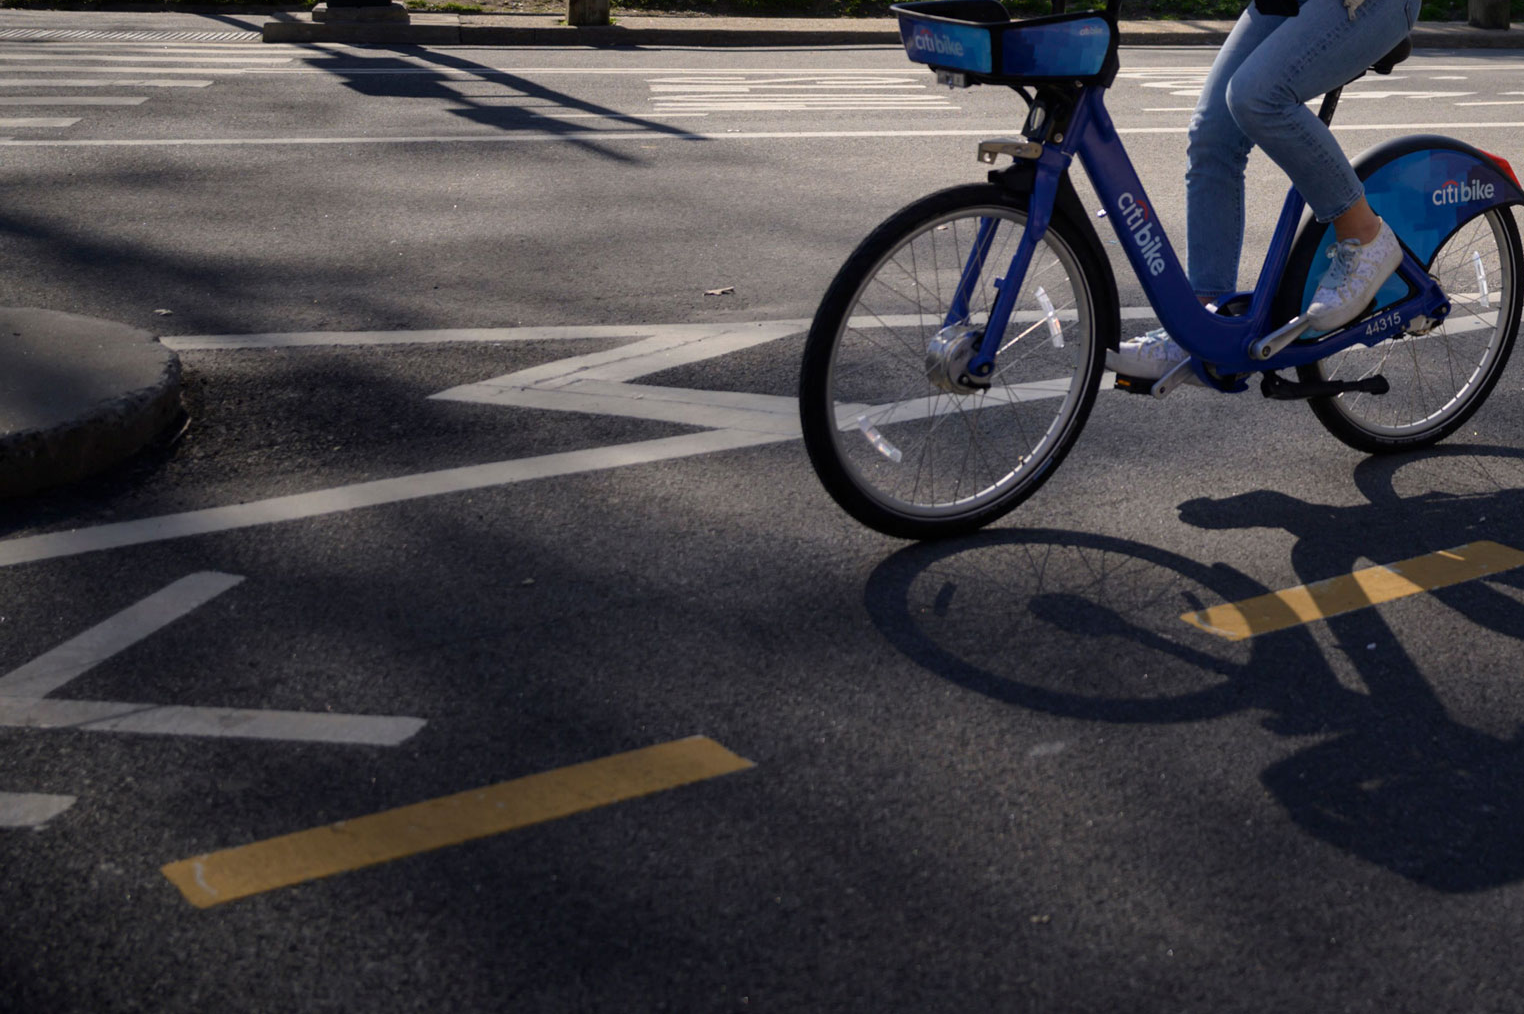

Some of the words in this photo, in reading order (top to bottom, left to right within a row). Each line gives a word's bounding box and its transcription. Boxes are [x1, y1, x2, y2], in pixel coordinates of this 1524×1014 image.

[915, 30, 935, 53] citi
[936, 35, 964, 57] bike
[1432, 180, 1458, 206] citi
[1461, 179, 1494, 202] bike
[1118, 192, 1147, 231] citi
[1134, 222, 1166, 276] bike
[1365, 312, 1401, 336] 44315
